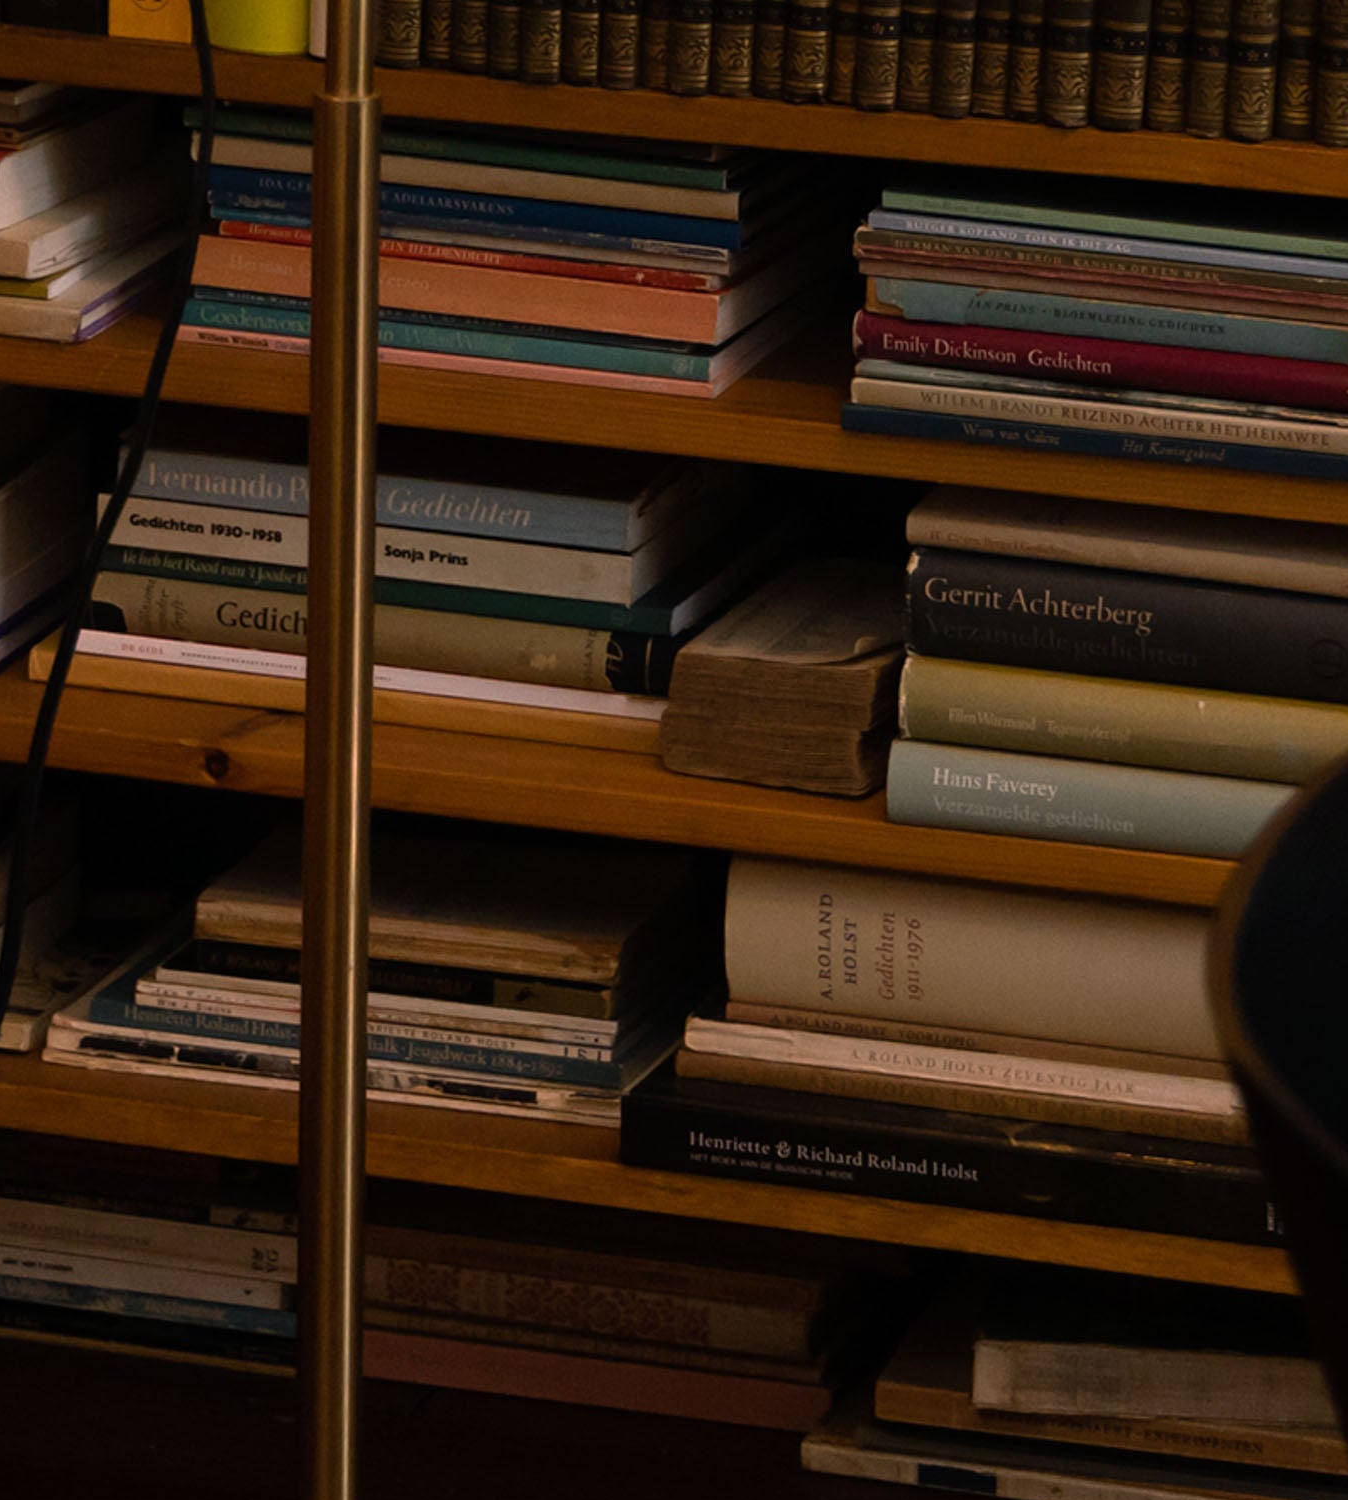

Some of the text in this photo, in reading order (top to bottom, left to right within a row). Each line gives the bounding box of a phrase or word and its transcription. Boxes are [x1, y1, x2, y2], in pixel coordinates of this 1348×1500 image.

[883, 334, 1112, 374] Emily Dickinson Gedichten
[130, 513, 282, 543] Gedichten 1930-1958
[384, 546, 469, 568] Sonja Prins
[925, 576, 1154, 636] Gerrit Achterberg
[933, 767, 1058, 801] Hans Faverey
[688, 1130, 978, 1184] Henriette & Richard Roland Holst
